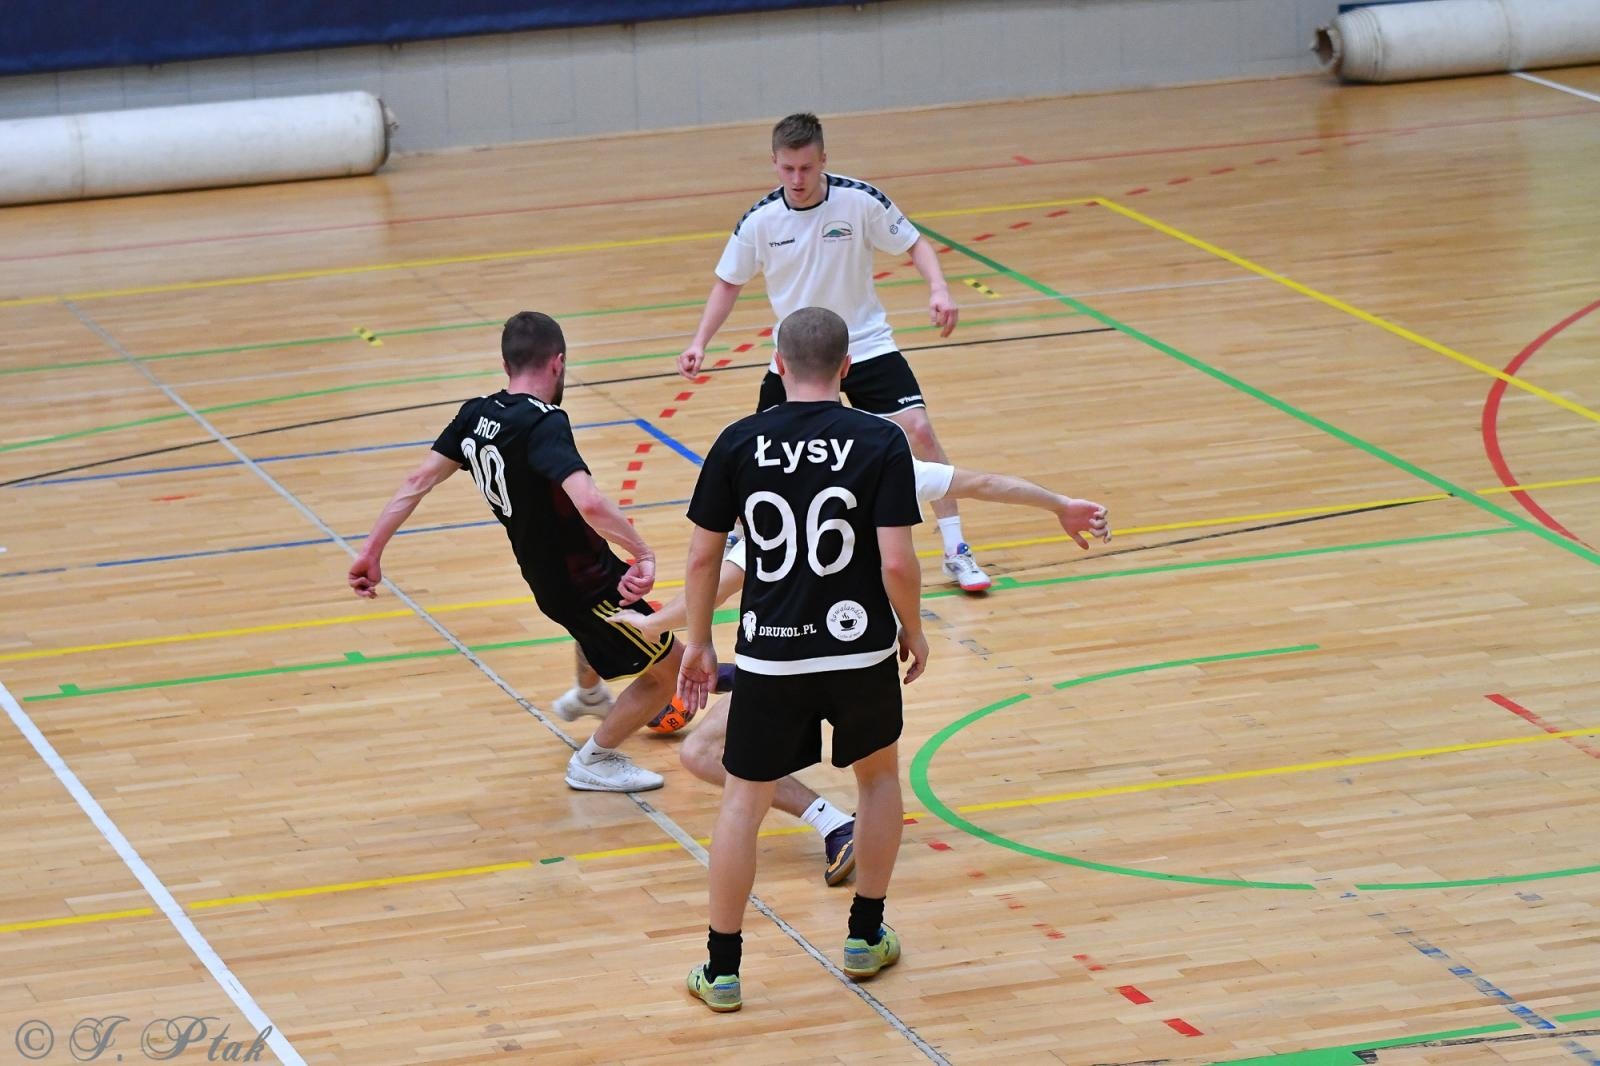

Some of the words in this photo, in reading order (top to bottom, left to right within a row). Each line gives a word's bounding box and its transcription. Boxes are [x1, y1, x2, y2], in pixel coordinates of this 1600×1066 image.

[754, 435, 855, 474] Łysy
[744, 486, 858, 583] 96
[758, 623, 817, 638] DRUKOL.PL
